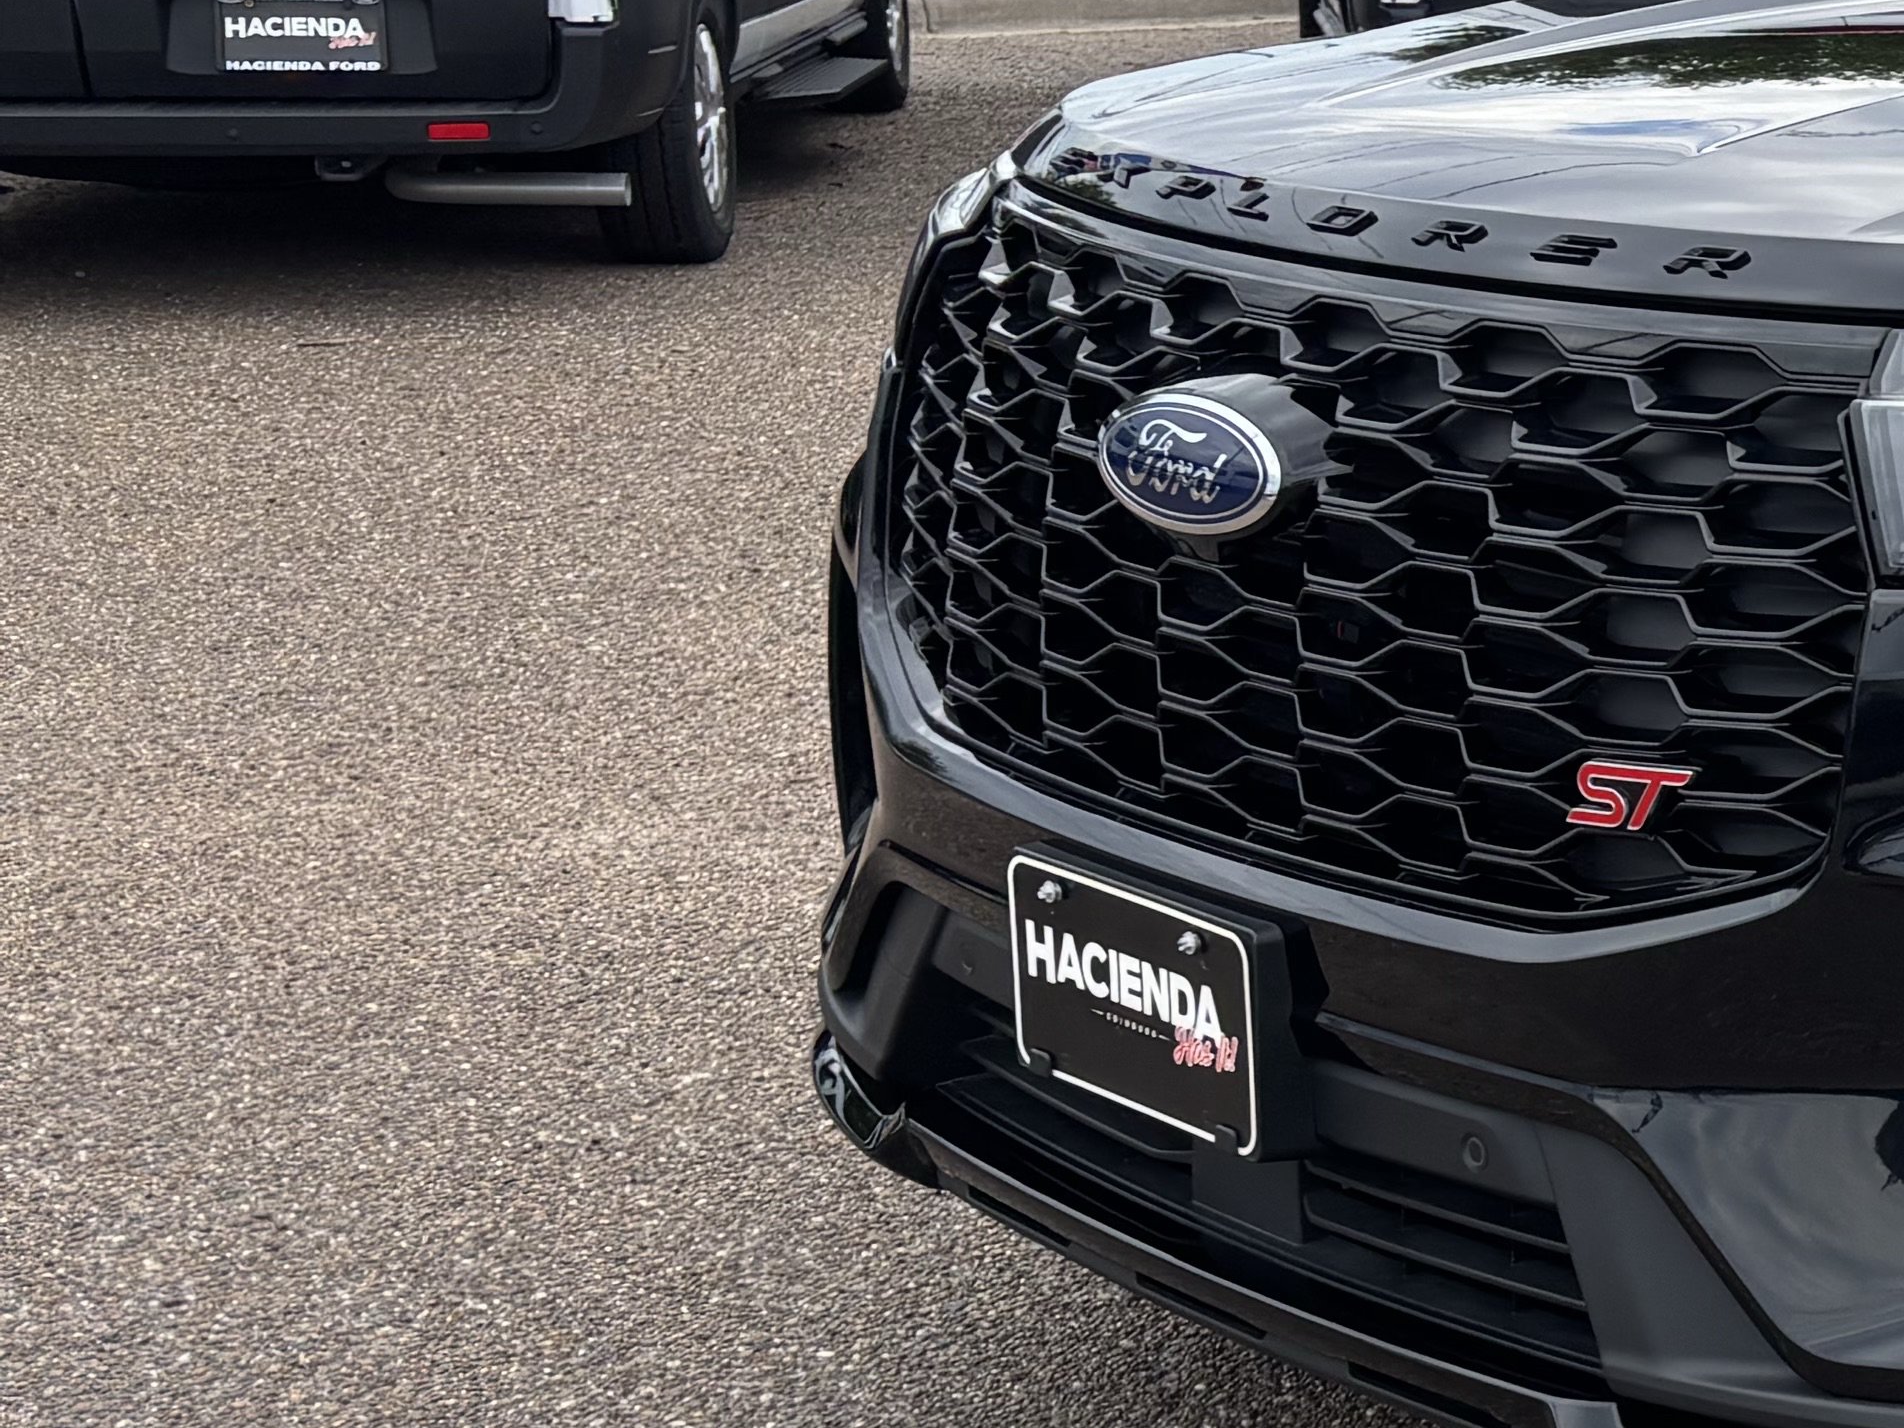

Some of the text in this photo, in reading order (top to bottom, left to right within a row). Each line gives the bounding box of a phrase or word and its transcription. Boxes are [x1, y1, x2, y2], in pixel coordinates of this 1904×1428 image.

[224, 16, 365, 39] HACIENDA
[225, 60, 381, 72] HACIENDA FORD
[1048, 146, 1753, 280] EXPLORER
[1126, 418, 1228, 505] Ford
[1565, 759, 1694, 831] ST
[1024, 918, 1226, 1049] HACIENDA
